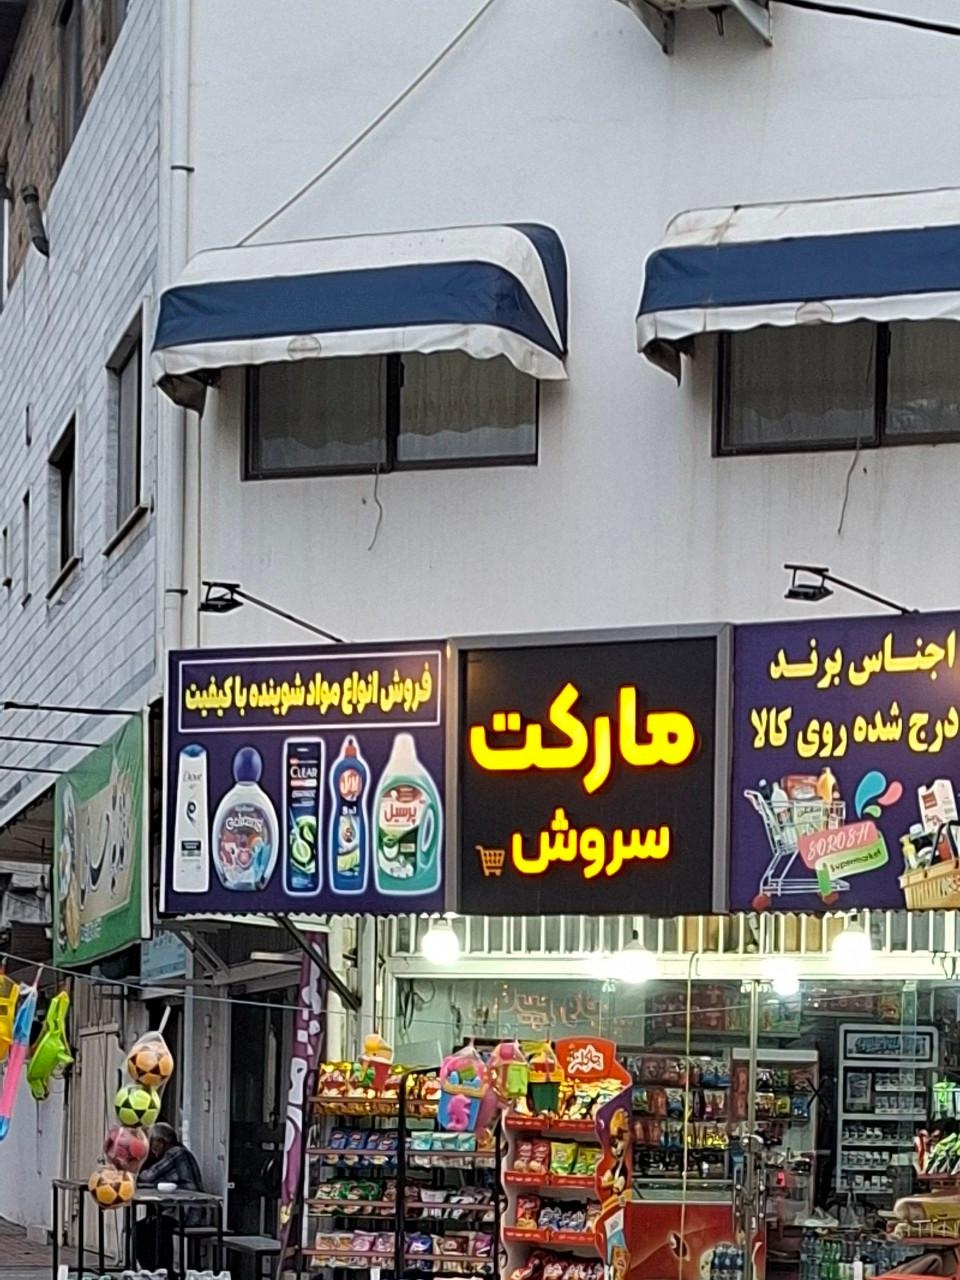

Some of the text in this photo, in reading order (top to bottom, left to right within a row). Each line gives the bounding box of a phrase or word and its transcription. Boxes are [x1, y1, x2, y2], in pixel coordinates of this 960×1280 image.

[770, 638, 842, 688] برند
[849, 630, 956, 685] اجناس
[184, 662, 433, 717] فروش انواع مواد شوینده با کیفیت
[470, 682, 695, 793] مارکت
[751, 706, 792, 748] کالا
[797, 719, 847, 757] روی
[853, 701, 902, 742] شده
[908, 706, 959, 752] درج
[290, 766, 317, 778] CLEAR
[384, 803, 417, 825] پرسیل
[512, 807, 670, 879] سروش
[807, 823, 871, 860] SOROSH
